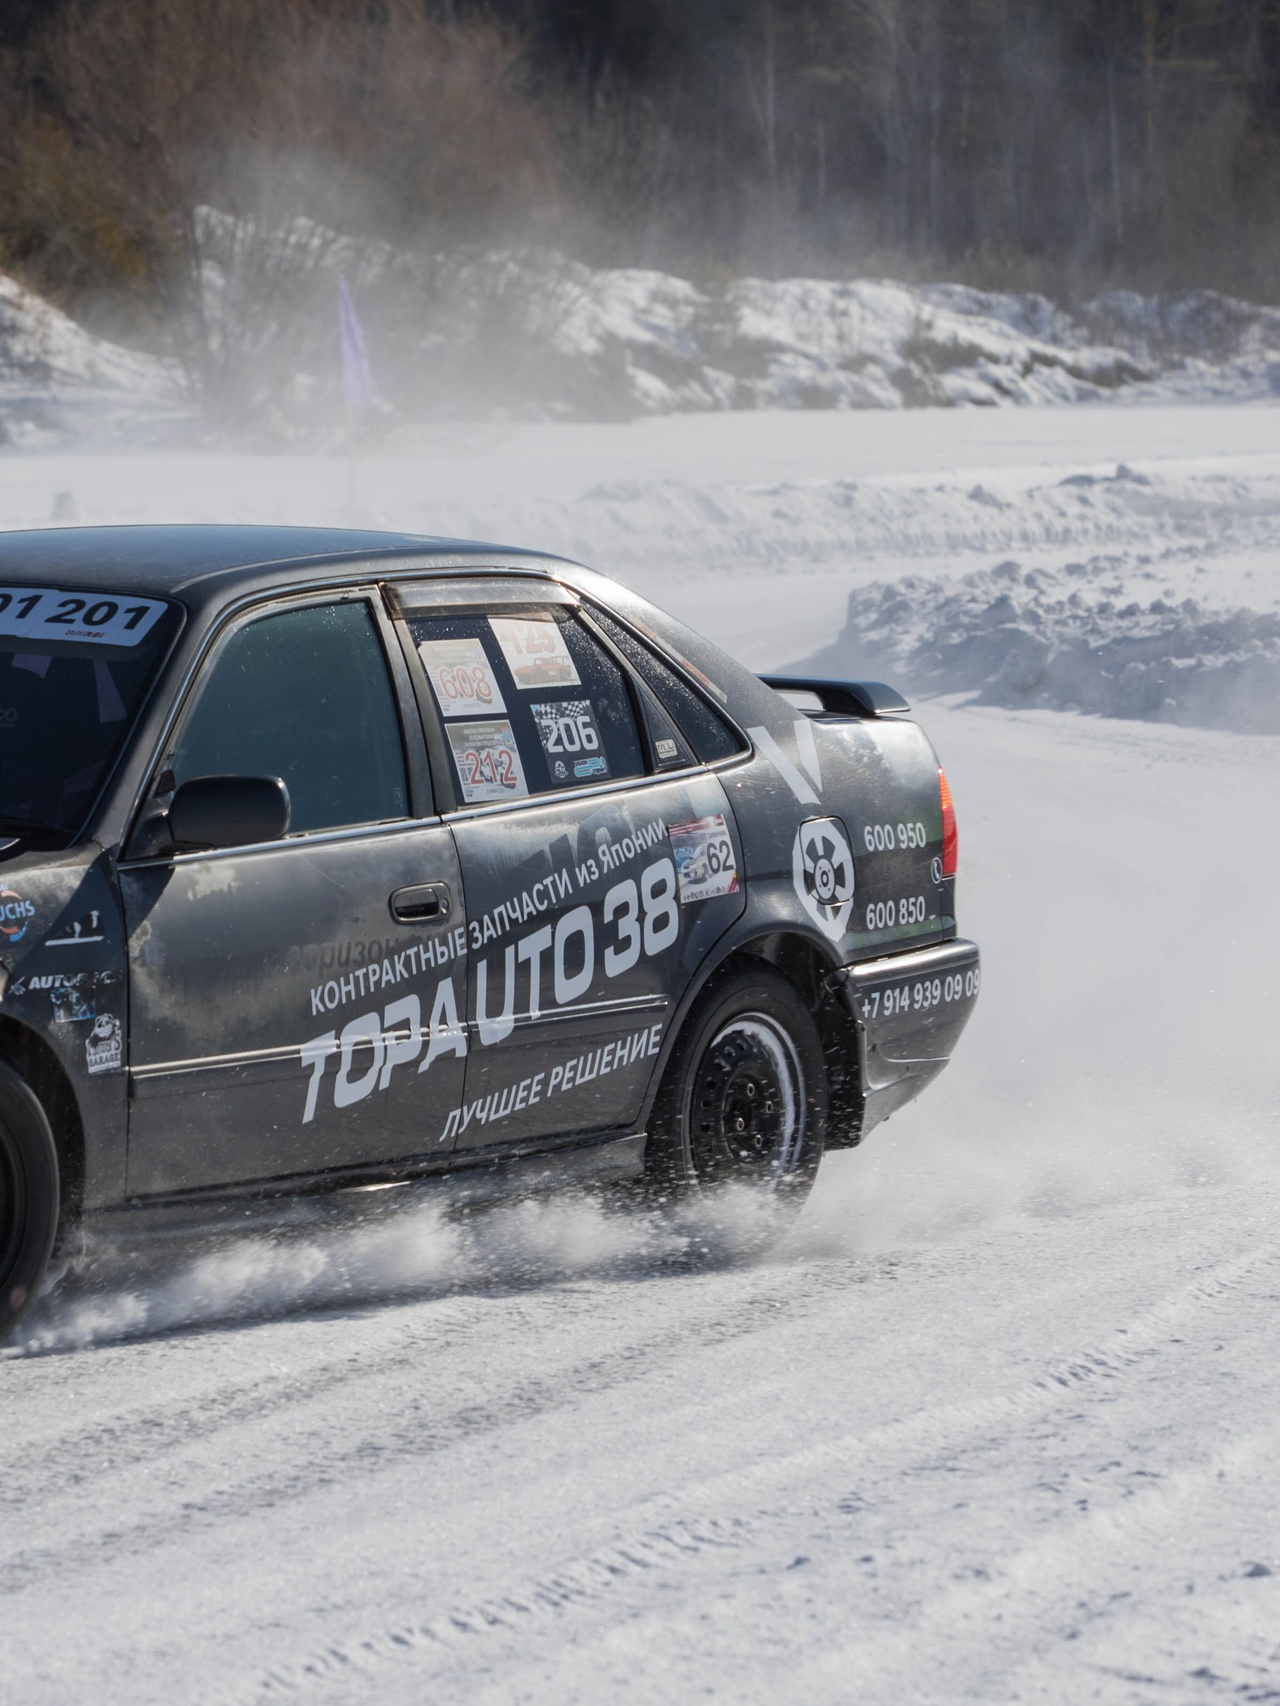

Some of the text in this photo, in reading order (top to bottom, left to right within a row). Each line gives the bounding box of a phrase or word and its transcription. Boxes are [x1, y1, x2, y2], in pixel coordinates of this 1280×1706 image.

[44, 599, 151, 630] 201
[438, 665, 492, 700] 608
[540, 716, 599, 753] 206
[465, 749, 518, 785] 212
[864, 822, 926, 851] 600 950
[707, 840, 734, 874] 62
[866, 896, 925, 929] 600 850
[310, 926, 467, 1016] КОНТРАКТНЫЕ
[470, 869, 573, 949] ЗАПЧАСТИ
[883, 985, 910, 1016] 914
[913, 979, 941, 1009] 939
[945, 973, 962, 1002] 09
[965, 968, 981, 997] 09
[439, 1023, 663, 1142] ЛУЧШЕЕ РЕШЕНИЕ
